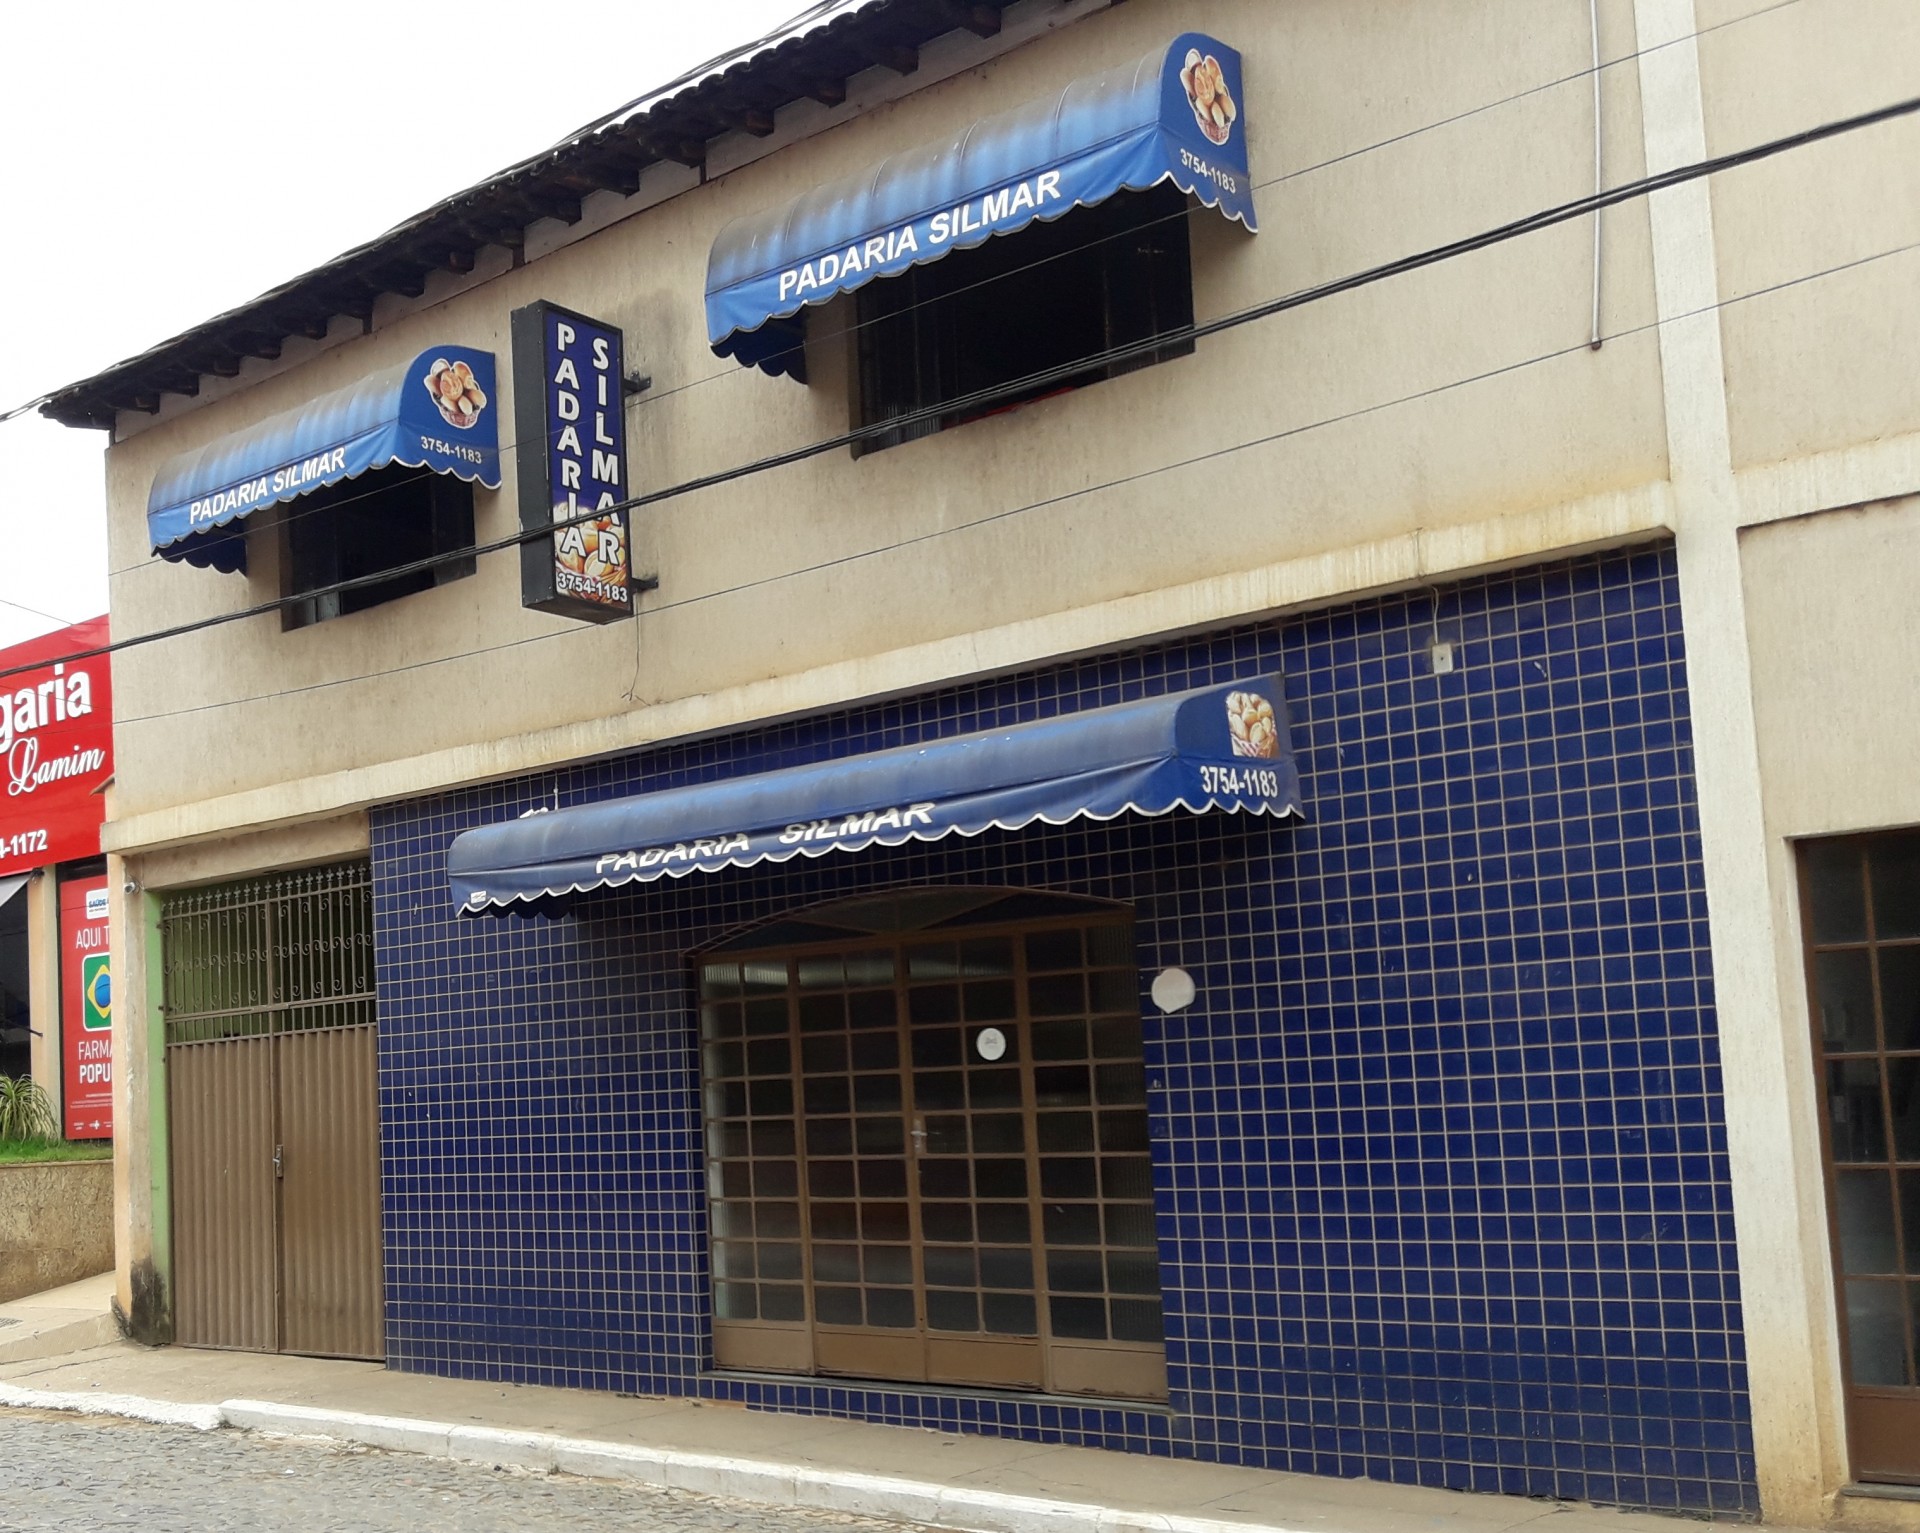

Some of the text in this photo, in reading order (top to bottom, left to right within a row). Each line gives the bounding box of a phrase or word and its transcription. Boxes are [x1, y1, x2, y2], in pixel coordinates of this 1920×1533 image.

[1179, 148, 1237, 195] 3754-1183
[778, 169, 1062, 301] PADARIA SILMAR
[420, 435, 483, 465] 3754-1183
[553, 321, 588, 558] PADARIA
[591, 336, 622, 566] SILMAR
[189, 446, 347, 525] PADARIA SILMAR
[557, 571, 629, 603] 3754-1183
[8, 736, 106, 797] Lamim
[1200, 765, 1279, 798] 3754-1183
[595, 802, 936, 874] PADARIA SILMAR
[75, 926, 102, 950] AQUI
[78, 1039, 113, 1061] FARM
